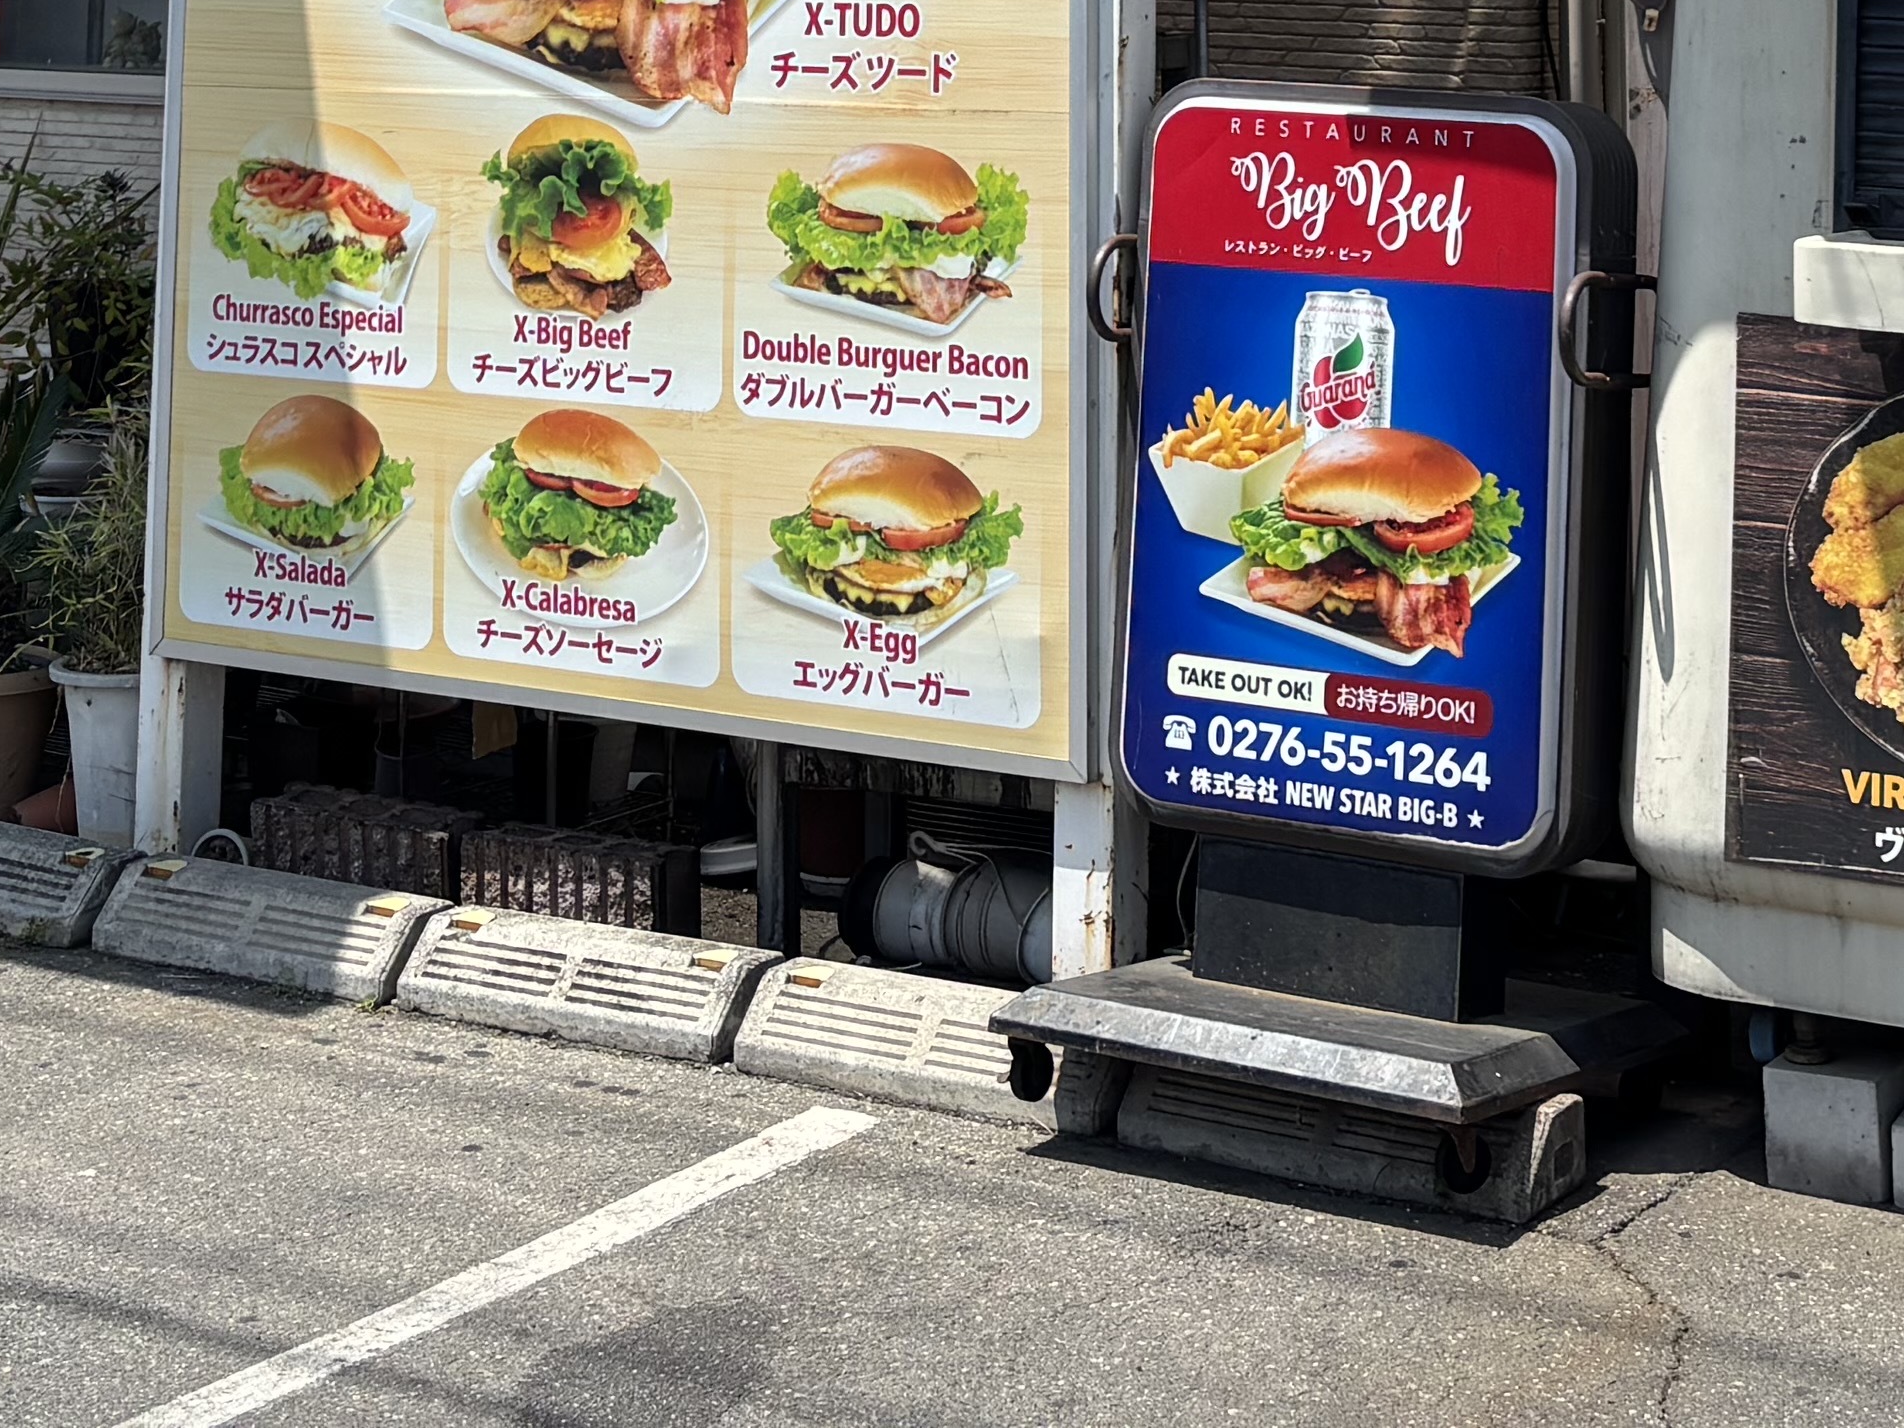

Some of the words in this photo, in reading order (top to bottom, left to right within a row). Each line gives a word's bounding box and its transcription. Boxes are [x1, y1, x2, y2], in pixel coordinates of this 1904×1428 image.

[803, 1, 921, 38] X-TUDO
[1230, 117, 1475, 148] RESTAURANT
[1229, 150, 1336, 242] Big
[1334, 158, 1472, 267] Beef
[212, 293, 314, 328] Churrasco
[318, 301, 403, 337] Especial
[512, 314, 573, 352] X-Big
[579, 318, 632, 351] Beef
[472, 352, 673, 398] チーズビッグビーフ
[742, 330, 832, 366] Double
[837, 336, 942, 378] Burguer
[948, 344, 1029, 380] Bacon
[740, 371, 1030, 425] ダブルバーガーベーコン
[1299, 360, 1377, 412] Guaraná
[253, 548, 347, 589] X-Salada
[224, 585, 376, 632] サラダバーガー
[500, 577, 637, 624] X-Calabresa
[476, 618, 663, 671] チーズソーセージ
[842, 618, 918, 664] X-Egg
[792, 659, 971, 707] エッグバーガー
[1177, 665, 1226, 691] TAKE
[1230, 673, 1273, 697] OUT
[1277, 679, 1313, 702] OK!
[1336, 683, 1476, 725] お持ち帰りOK!
[1207, 715, 1492, 793] 0276-55-1264
[1190, 766, 1279, 806] 株式会社
[1284, 780, 1335, 812] NEW
[1339, 788, 1393, 820] STAR
[1397, 796, 1459, 829] BIG-B
